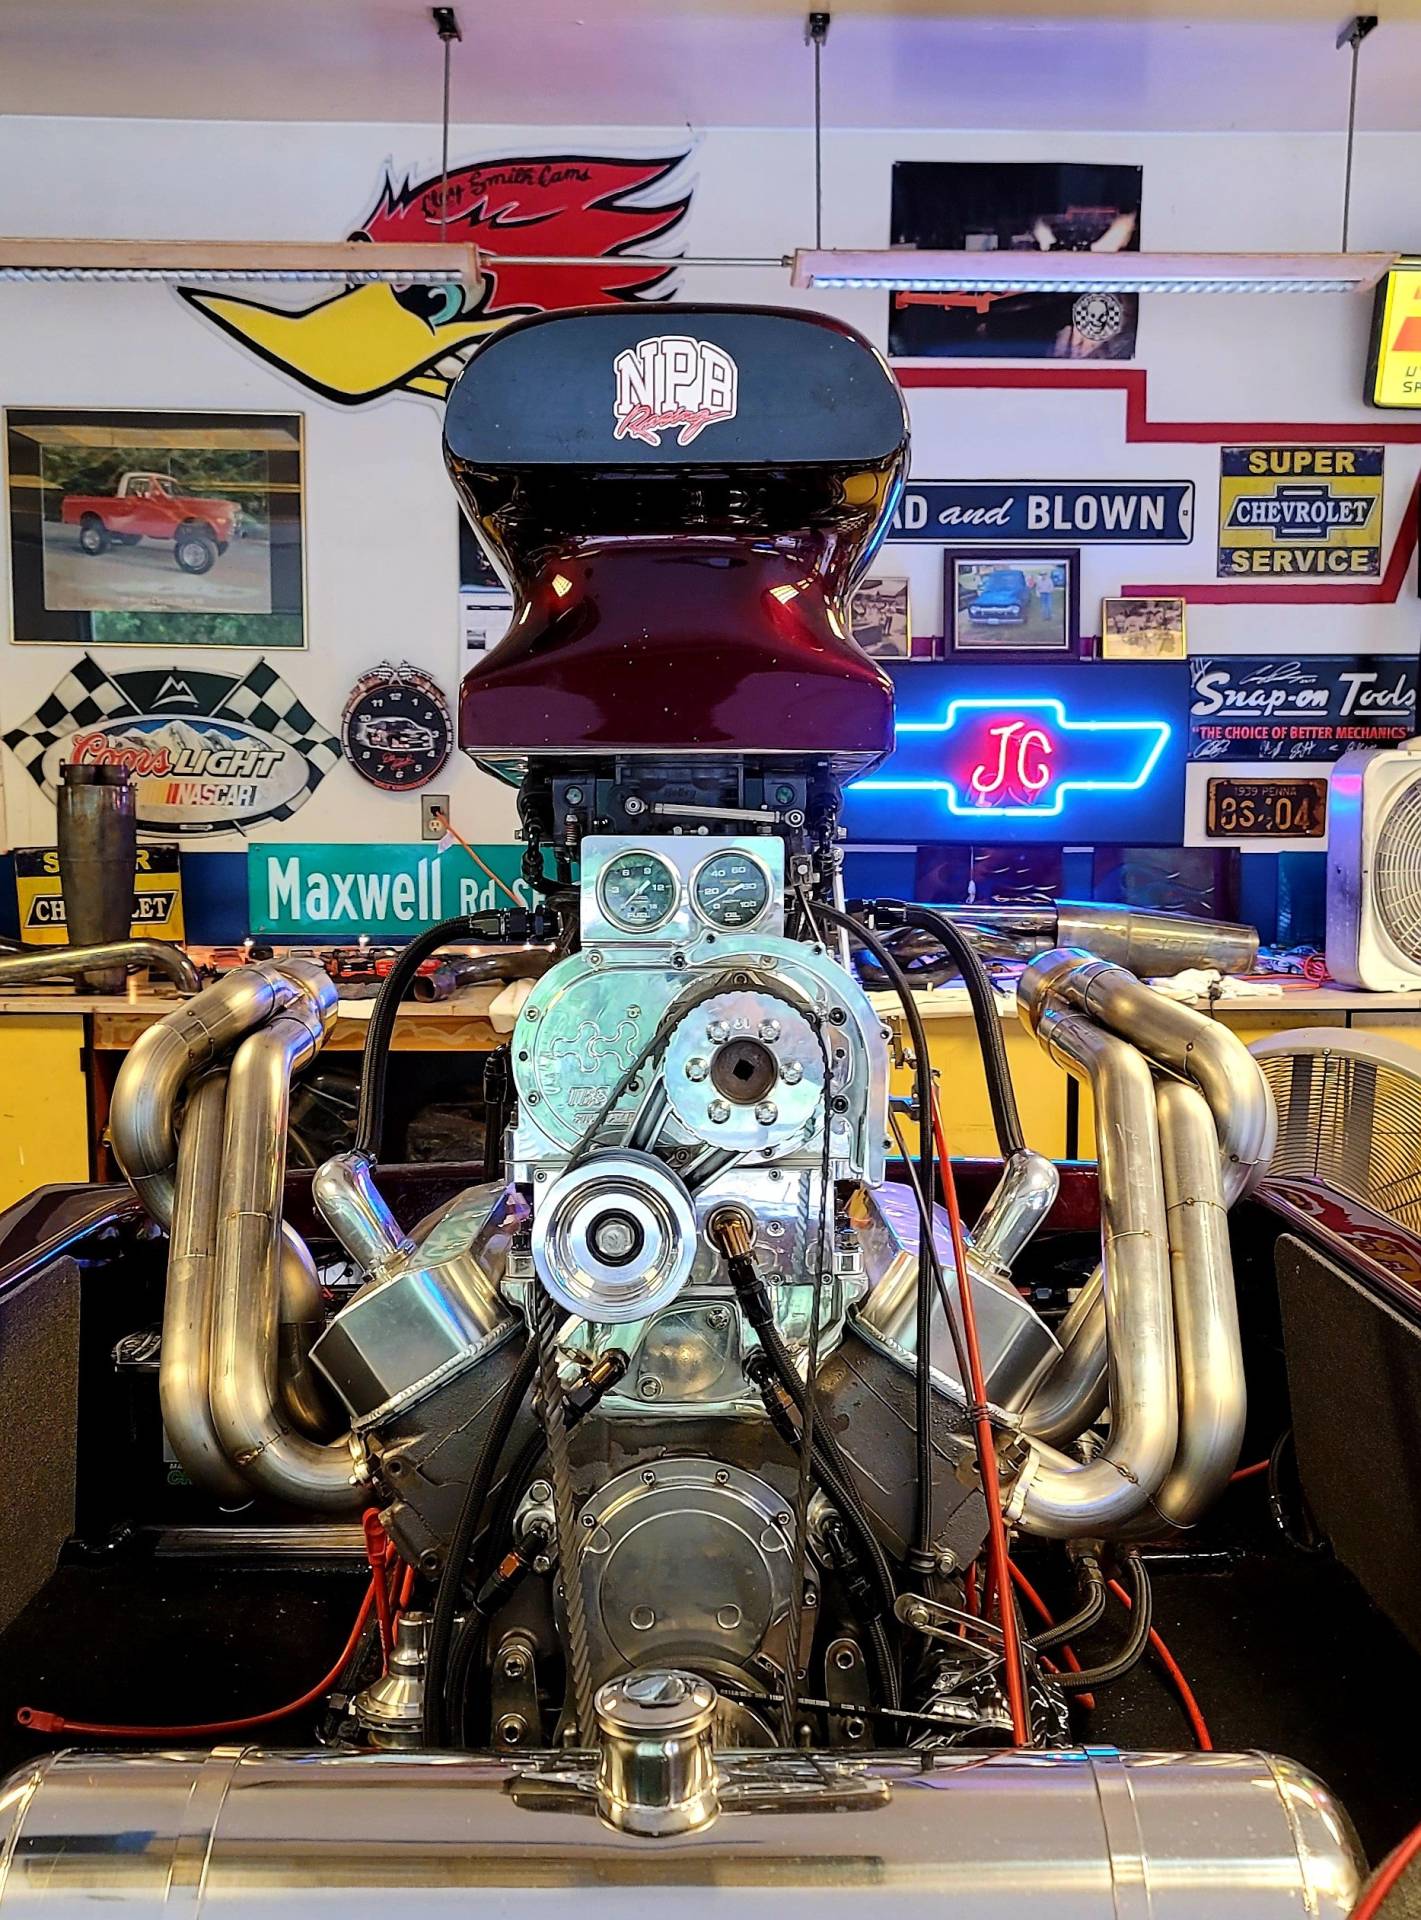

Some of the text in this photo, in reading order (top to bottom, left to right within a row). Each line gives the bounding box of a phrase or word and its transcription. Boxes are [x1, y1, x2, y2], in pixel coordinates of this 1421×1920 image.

[469, 166, 533, 196] Smith
[538, 164, 592, 187] Cams
[615, 337, 736, 416] NPB
[616, 404, 735, 444] Racing
[1248, 451, 1356, 474] SUPER
[938, 498, 1015, 526] and
[1027, 495, 1165, 530] BLOWN
[1236, 501, 1368, 523] CHEVROLET
[1231, 550, 1370, 573] SERVICE
[1190, 672, 1330, 717] Snap-on
[1338, 672, 1417, 717] Tools
[1224, 726, 1269, 739] CHOICE
[1271, 726, 1288, 739] OF
[1290, 726, 1331, 739] BETTER
[172, 750, 285, 777] LIGHT
[177, 783, 258, 806] NASCAR
[1262, 786, 1297, 797] PENNA
[267, 856, 442, 921] Maxwell
[459, 878, 496, 917] Rd
